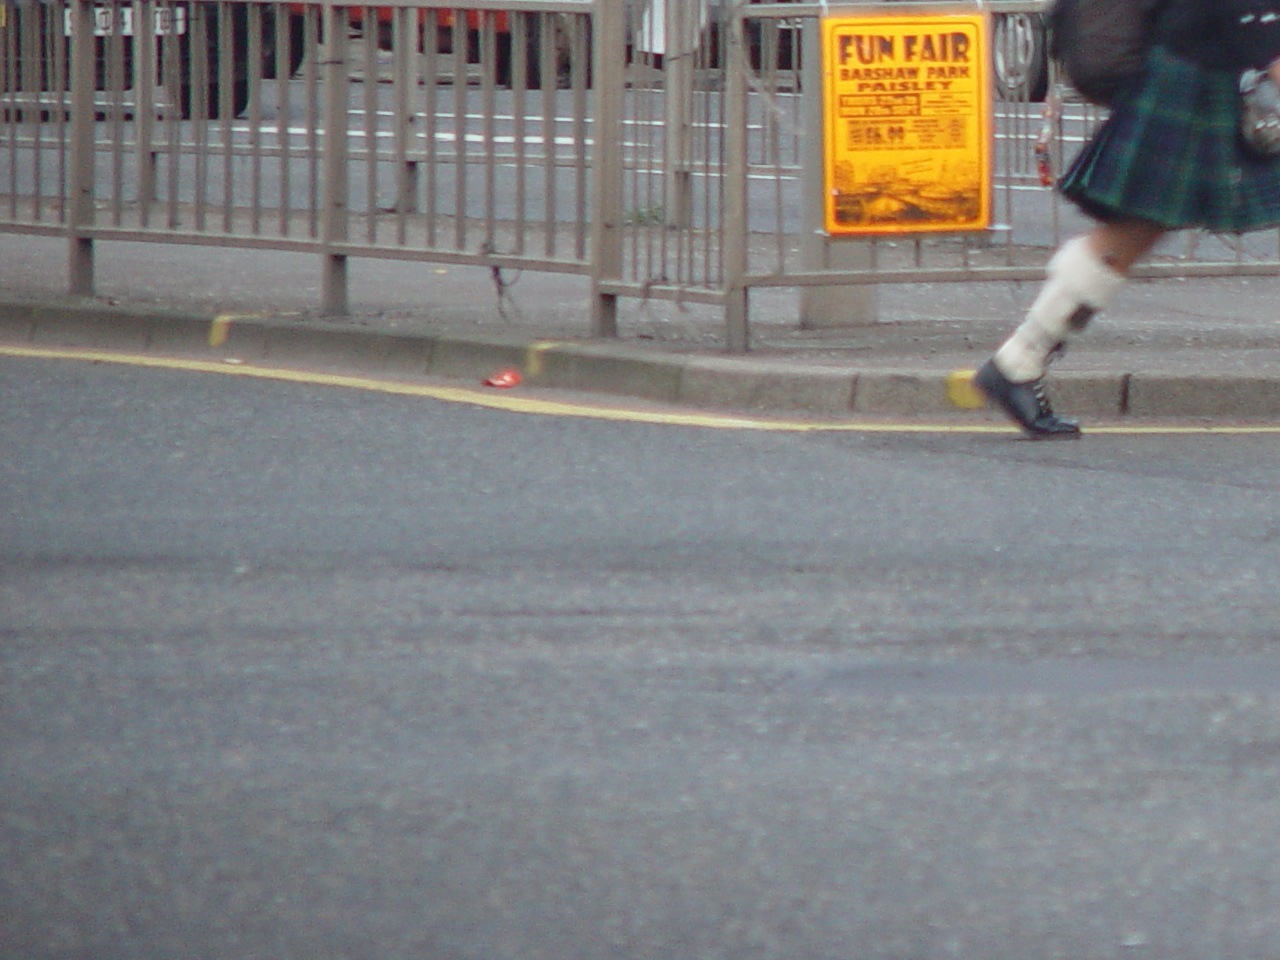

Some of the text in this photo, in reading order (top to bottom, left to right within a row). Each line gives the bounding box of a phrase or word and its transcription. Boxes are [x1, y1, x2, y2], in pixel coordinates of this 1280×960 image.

[838, 31, 971, 65] FUN FAIR
[839, 65, 971, 82] BARSHAW PARK
[857, 80, 953, 92] PAISLEY
